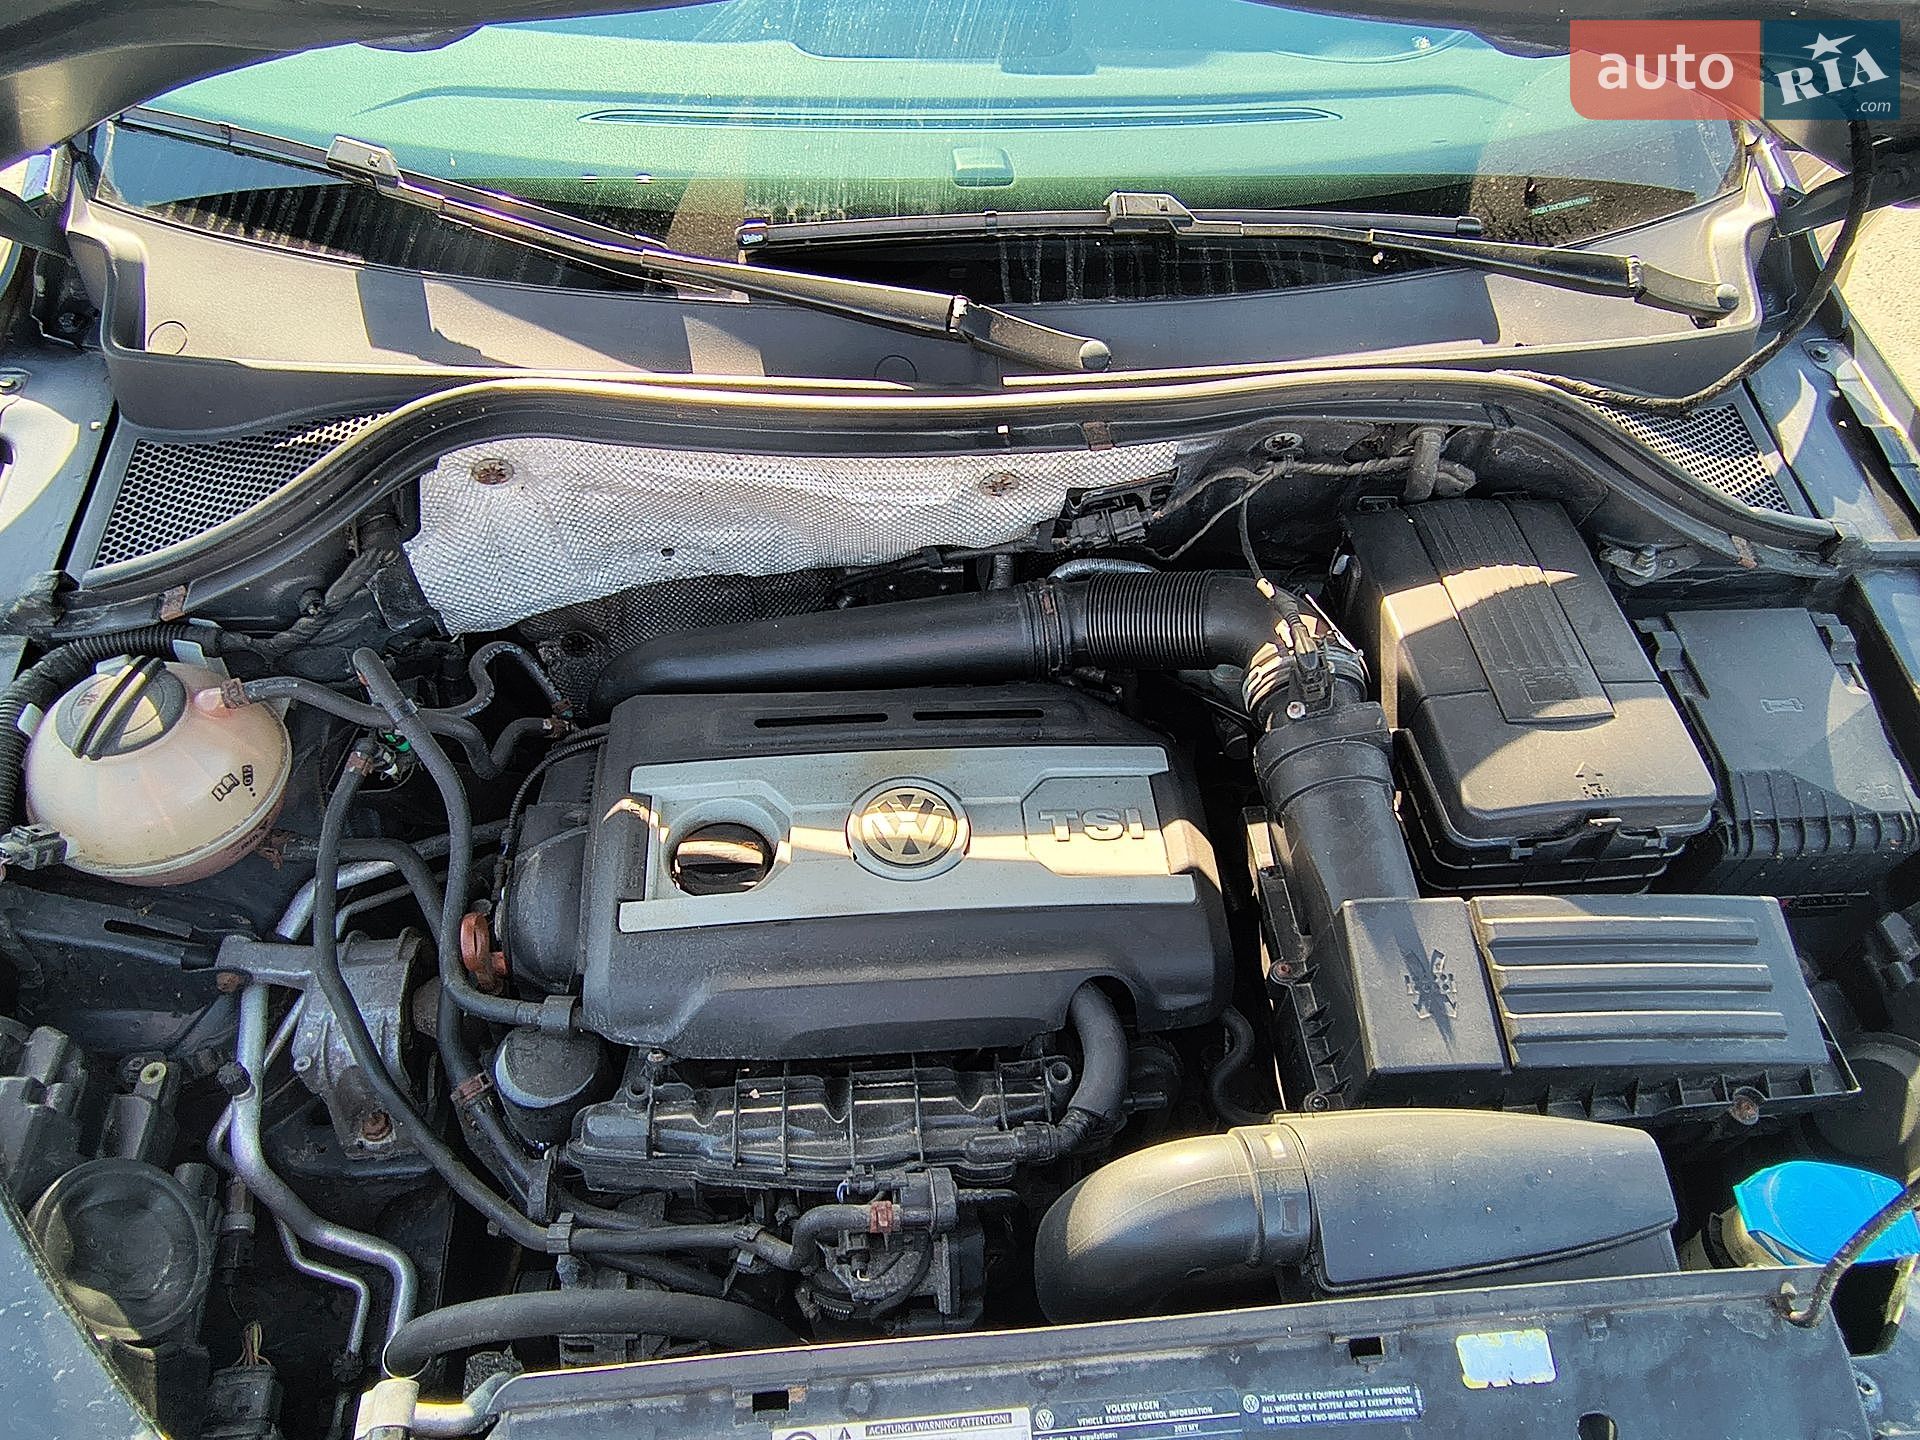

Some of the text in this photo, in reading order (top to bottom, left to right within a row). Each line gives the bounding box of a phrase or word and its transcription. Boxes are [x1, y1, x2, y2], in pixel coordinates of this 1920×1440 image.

[1039, 807, 1145, 842] TSI
[1260, 1394, 1276, 1403] THIS
[1277, 1392, 1303, 1402] VEHICLE
[1304, 1392, 1311, 1400] IS
[1312, 1389, 1345, 1401] EQUIPPED
[1346, 1389, 1363, 1398] WITH
[1371, 1386, 1411, 1396] PERMANENT
[1105, 1400, 1160, 1414] VOLKSWAGEN
[1297, 1402, 1318, 1412] DRIVE
[1318, 1401, 1343, 1411] SYSTEM
[1344, 1400, 1359, 1409] AND
[1359, 1399, 1367, 1407] IS
[1367, 1397, 1393, 1407] EXEMPT
[1393, 1396, 1414, 1406] FROM
[868, 1413, 1010, 1436] ACHTUNG! WARNING! ATTENTION!
[1077, 1406, 1214, 1427] VEHICLE EMISSION CONTROL INFORMATION
[1276, 1415, 1300, 1424] TESTING
[1301, 1414, 1311, 1423] ON
[1348, 1410, 1367, 1419] DRIVE
